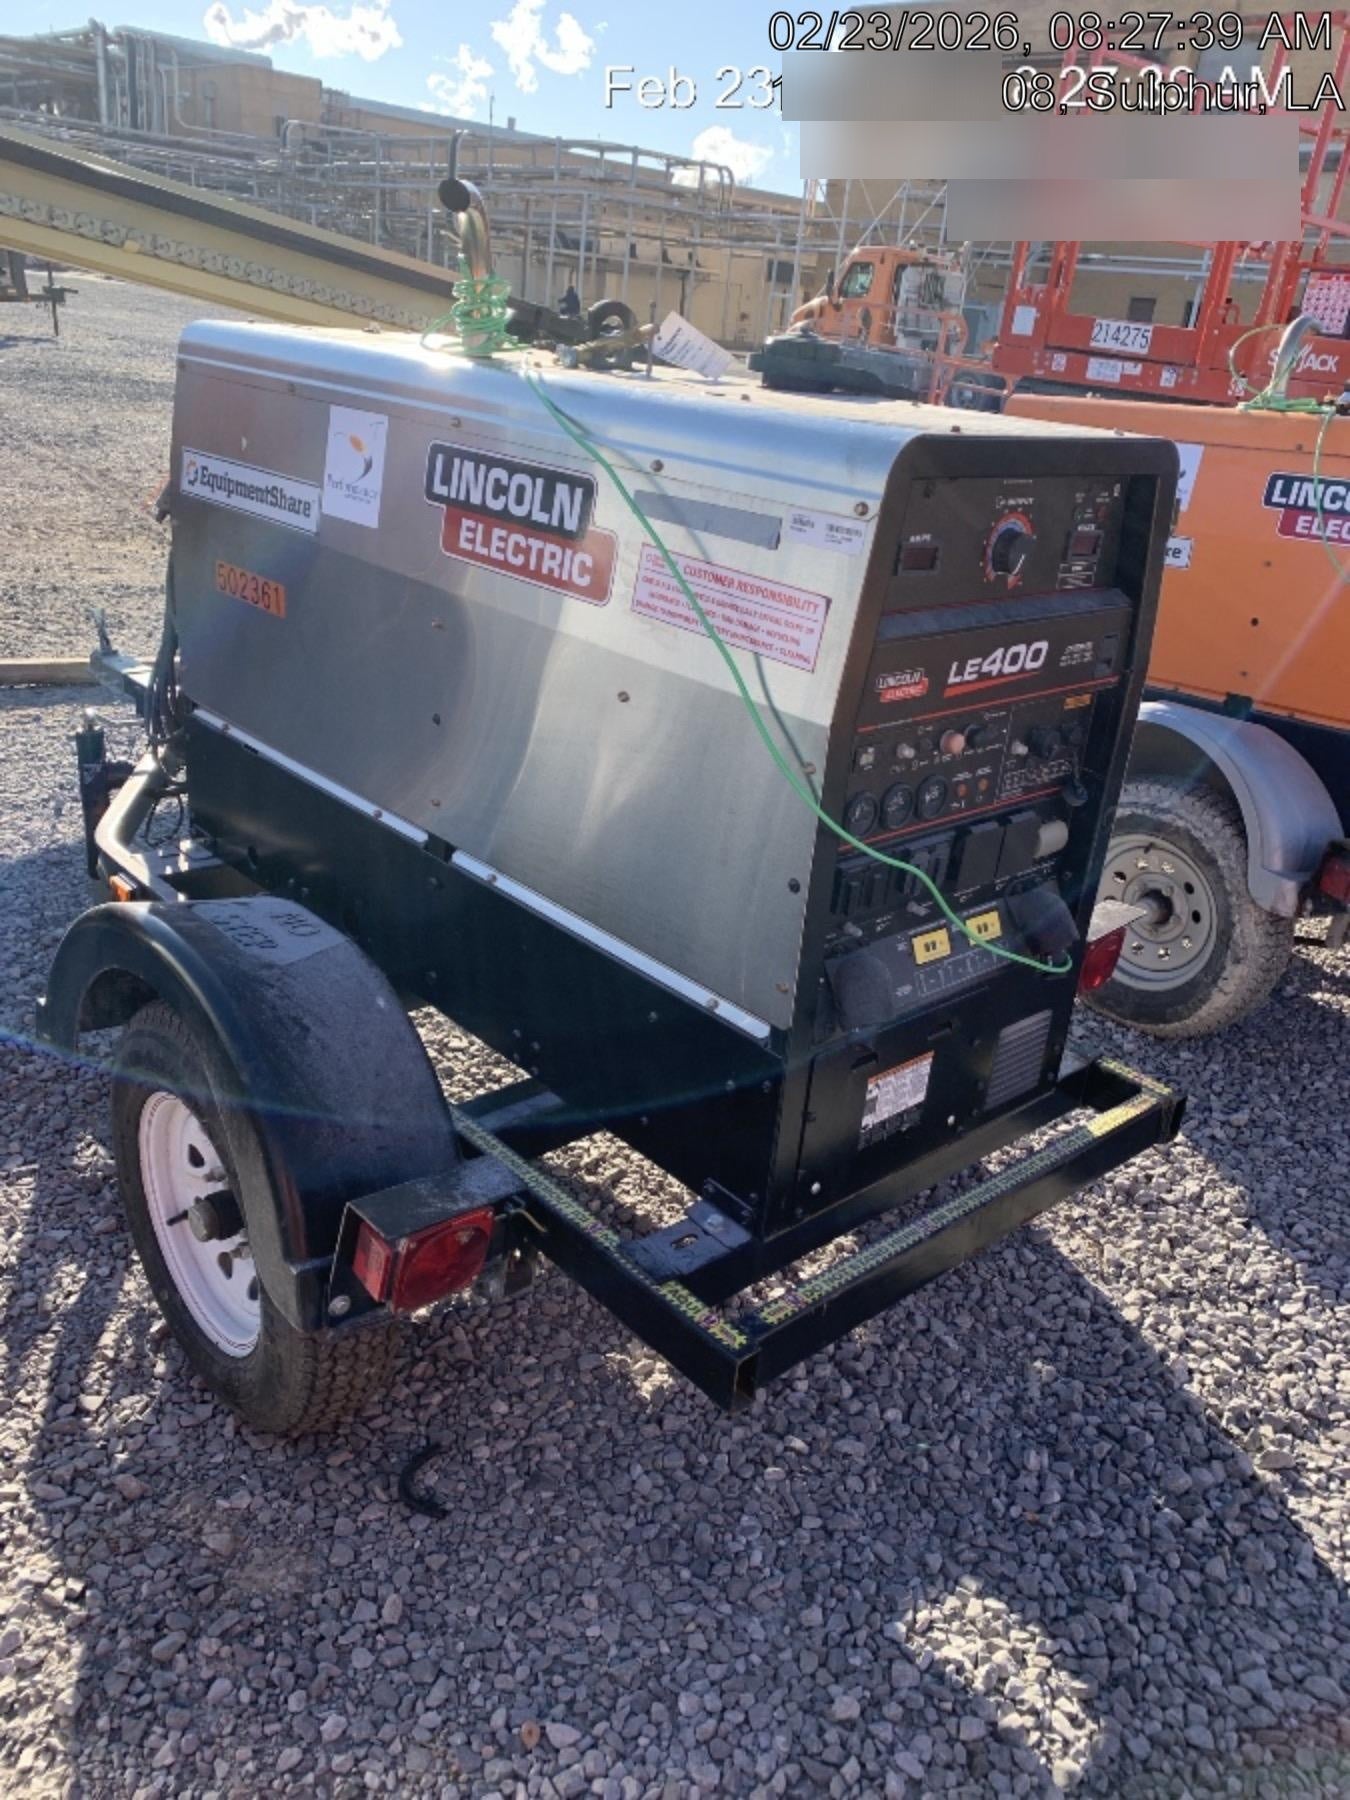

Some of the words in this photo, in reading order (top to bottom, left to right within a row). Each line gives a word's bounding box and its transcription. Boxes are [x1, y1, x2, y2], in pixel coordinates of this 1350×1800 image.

[1092, 322, 1150, 349] 214275
[200, 465, 311, 519] EquipmentShare
[432, 453, 584, 533] LINCOLN
[1271, 479, 1350, 513] LINC
[458, 516, 593, 587] ELECTRIC
[217, 563, 282, 616] 502361
[682, 564, 735, 589] CUSTOMER
[947, 639, 1049, 685] LE400
